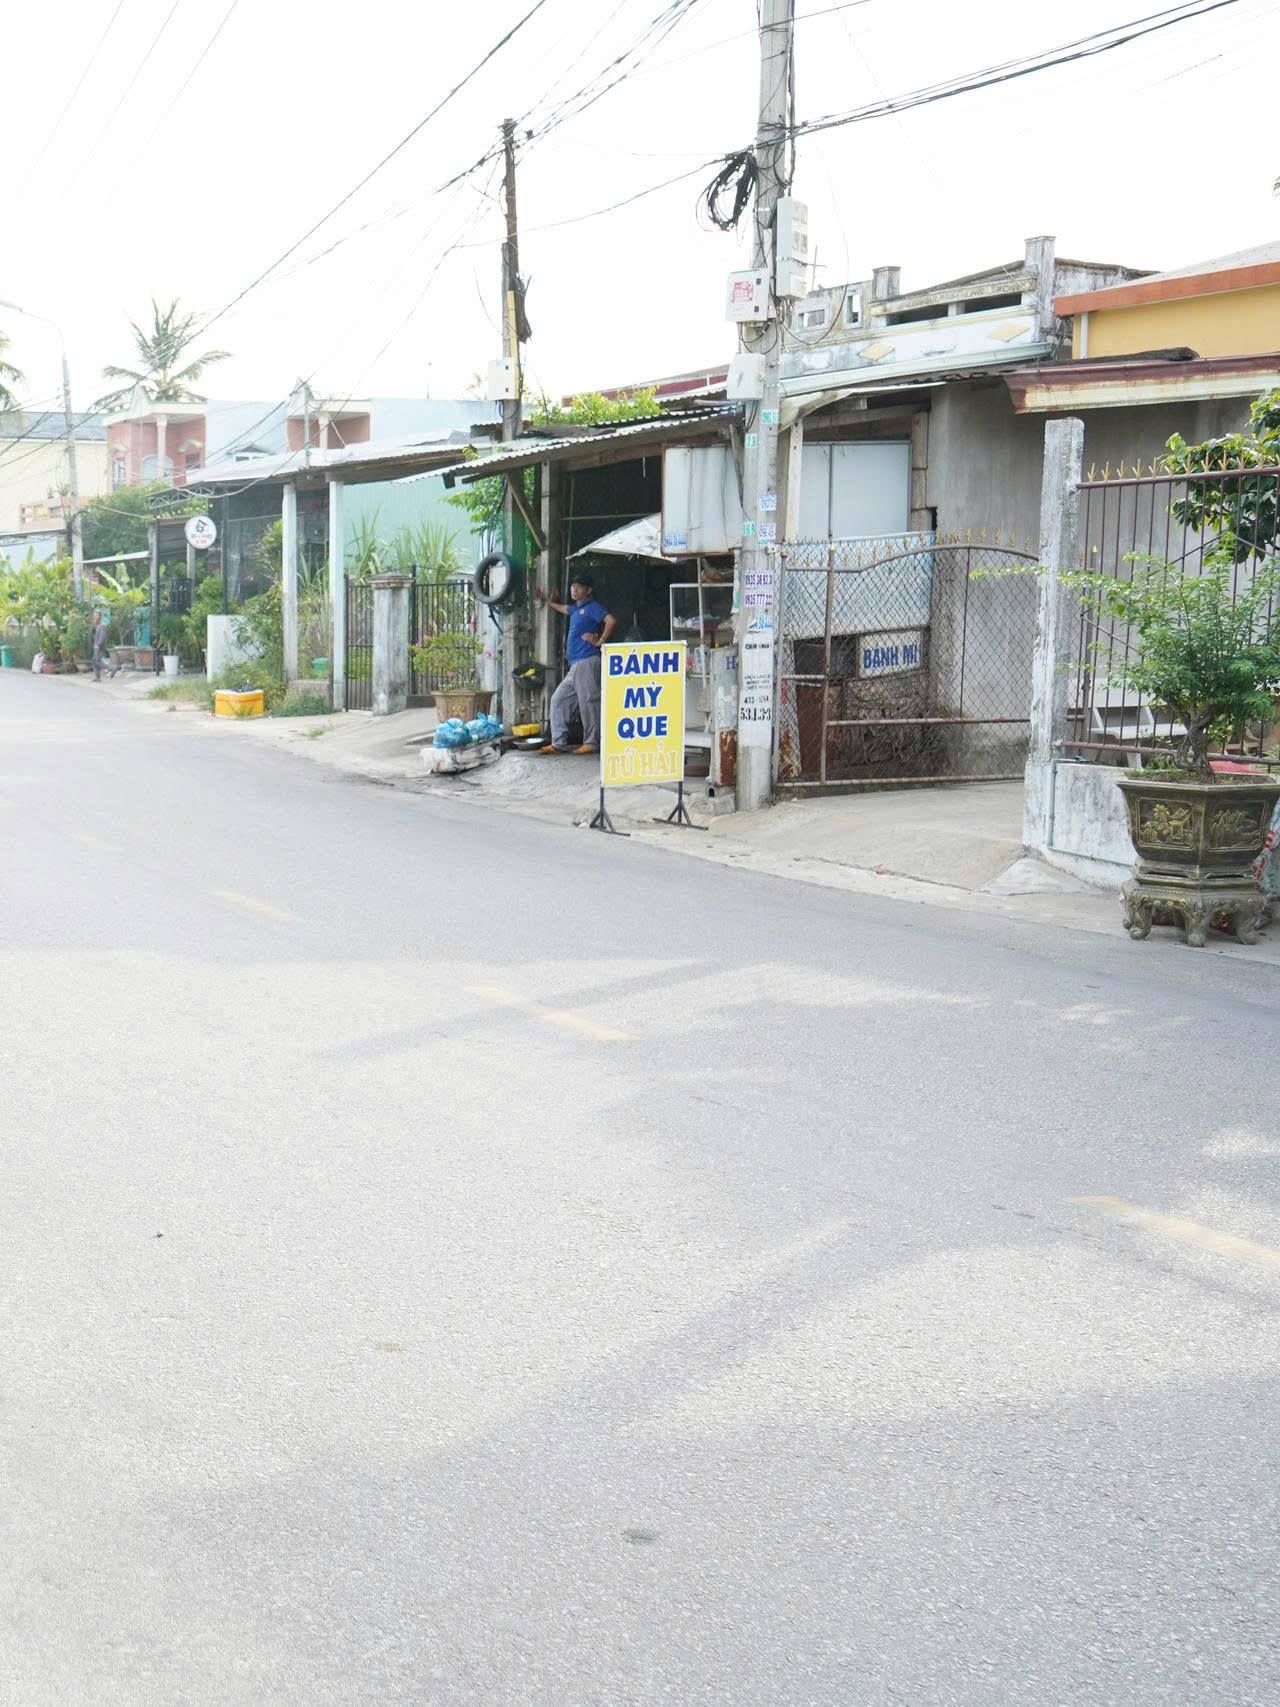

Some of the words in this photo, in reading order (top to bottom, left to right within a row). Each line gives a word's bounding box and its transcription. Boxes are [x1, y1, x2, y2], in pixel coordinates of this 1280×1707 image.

[609, 649, 680, 676] BÁNH
[624, 681, 663, 709] MỲ
[617, 715, 669, 740] QUE
[640, 741, 679, 778] HẢI
